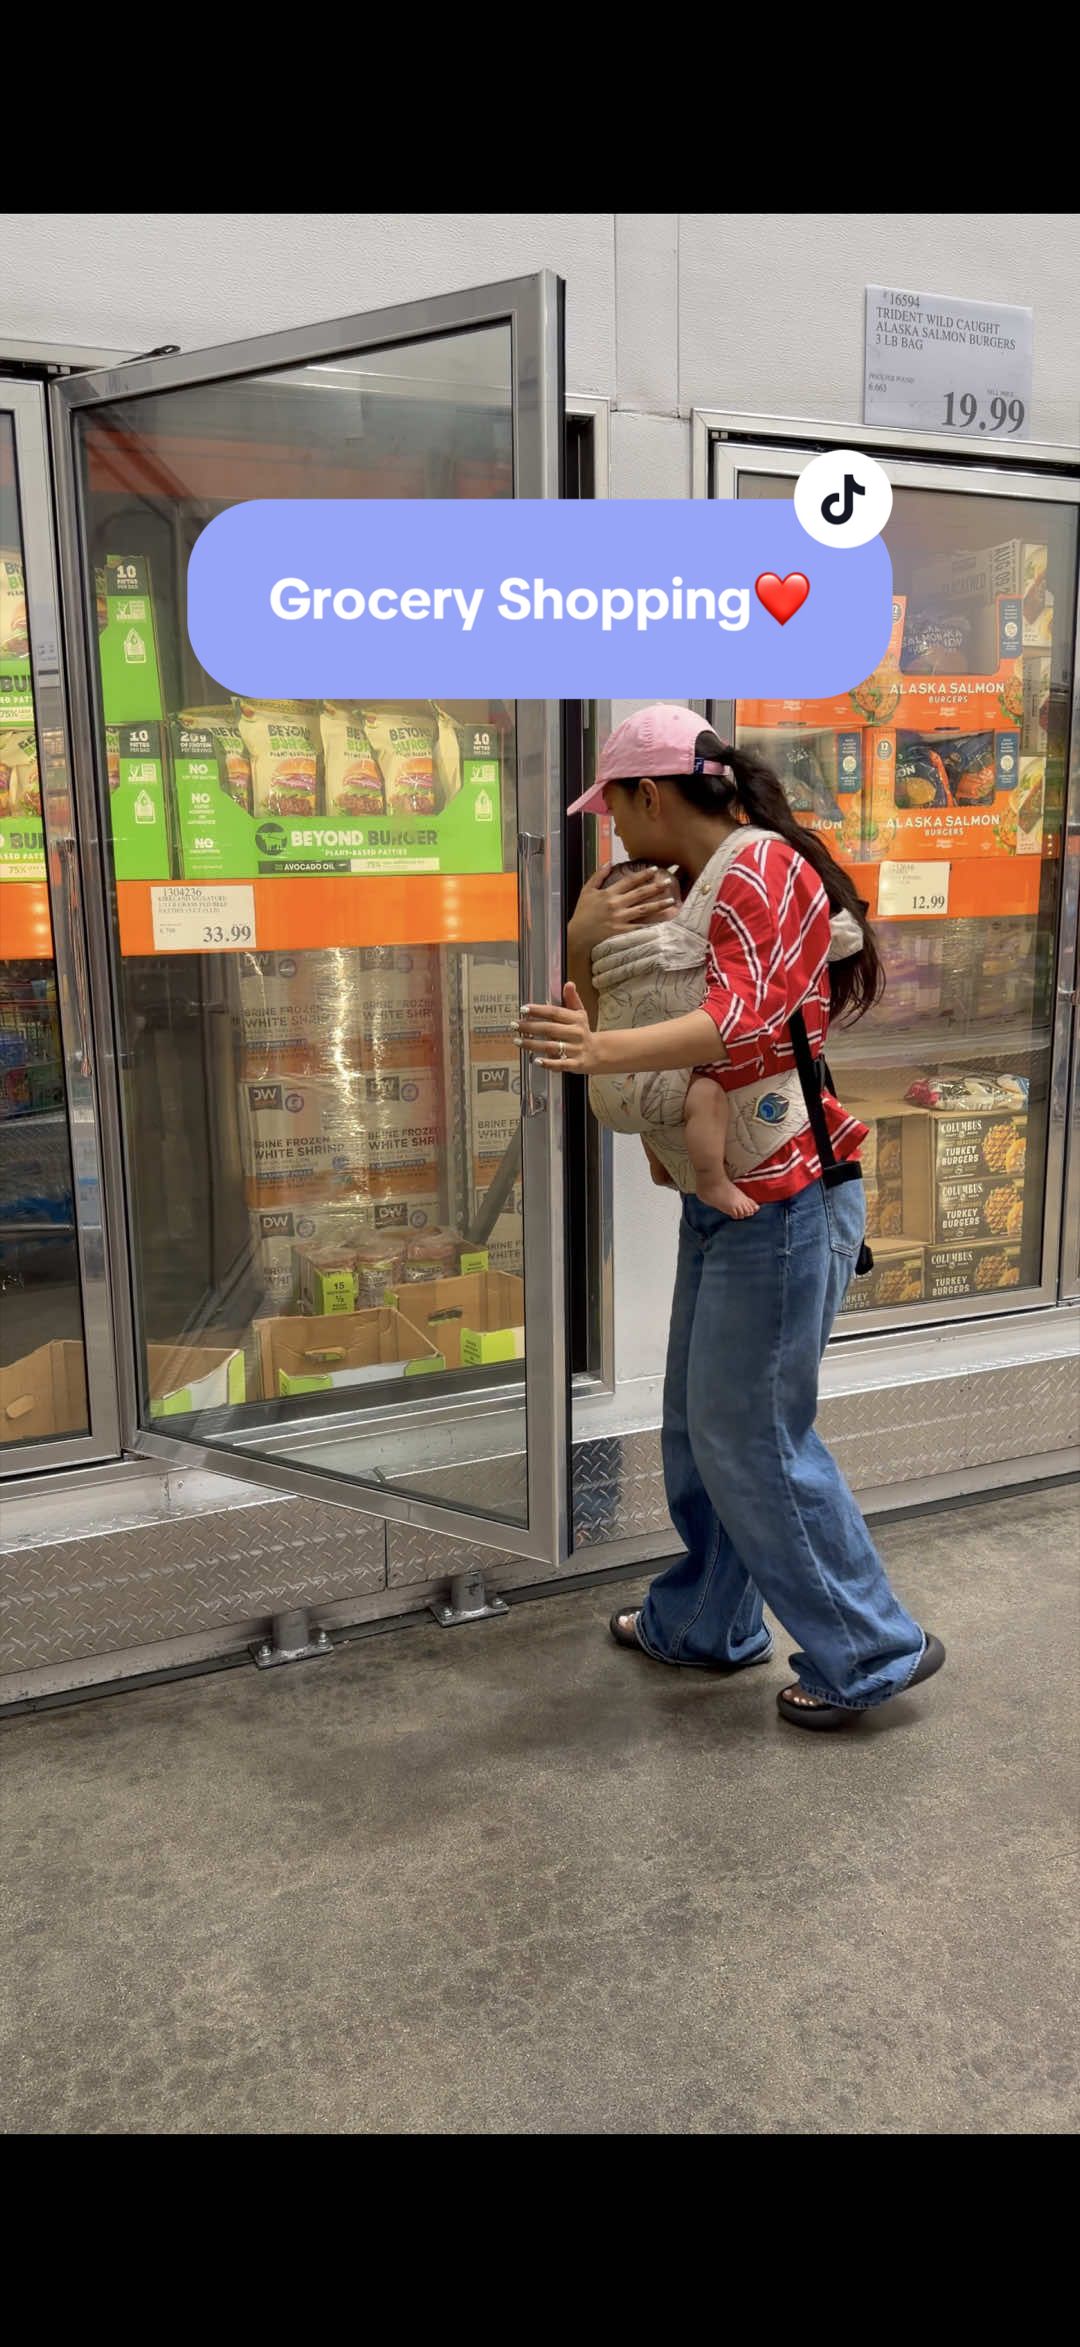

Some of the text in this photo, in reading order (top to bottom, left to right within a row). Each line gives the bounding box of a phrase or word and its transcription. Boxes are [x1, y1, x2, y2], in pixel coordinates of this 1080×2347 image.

[876, 306, 1001, 335] TRIDENT WILD CAUGHT
[876, 320, 1017, 351] ALASKA SALMON BURGERS
[876, 333, 923, 351] 3 LB BAG
[941, 391, 1025, 434] 19.99
[117, 565, 137, 578] 10
[890, 681, 1006, 696] ALASKA SALMON
[928, 695, 968, 705] BURGERS
[129, 730, 149, 742] 10
[473, 733, 490, 746] 10
[189, 763, 208, 775] NO
[191, 792, 210, 804] NO
[886, 814, 1000, 829] ALASKA SALMON
[290, 829, 438, 847] BEYOND BURGER
[924, 828, 964, 837] BURGERS
[194, 837, 214, 849] NO
[284, 863, 336, 871] AVOCADO OIL
[163, 887, 203, 897] 1304236
[912, 895, 945, 909] 12.99
[202, 925, 252, 943] 33.99
[474, 1003, 513, 1014] WHITE
[481, 1070, 506, 1083] DW
[477, 1119, 507, 1130] BRINE
[940, 1120, 983, 1134] COLUMBUS
[478, 1128, 516, 1140] WHITE
[286, 1135, 330, 1147] FROZEN
[368, 1138, 409, 1151] WHITE
[255, 1148, 294, 1161] WHITE
[945, 1145, 977, 1157] TURKEY
[941, 1154, 980, 1166] BURGERS
[942, 1183, 984, 1197] COLUMBUS
[378, 1204, 404, 1218] DW
[946, 1207, 978, 1220] TURKEY
[263, 1215, 289, 1229] DW
[942, 1216, 981, 1229] BURGERS
[931, 1250, 973, 1265] COLUMBUS
[333, 1282, 345, 1291] 15
[935, 1275, 968, 1287] TURKEY
[932, 1283, 970, 1297] BURGERS
